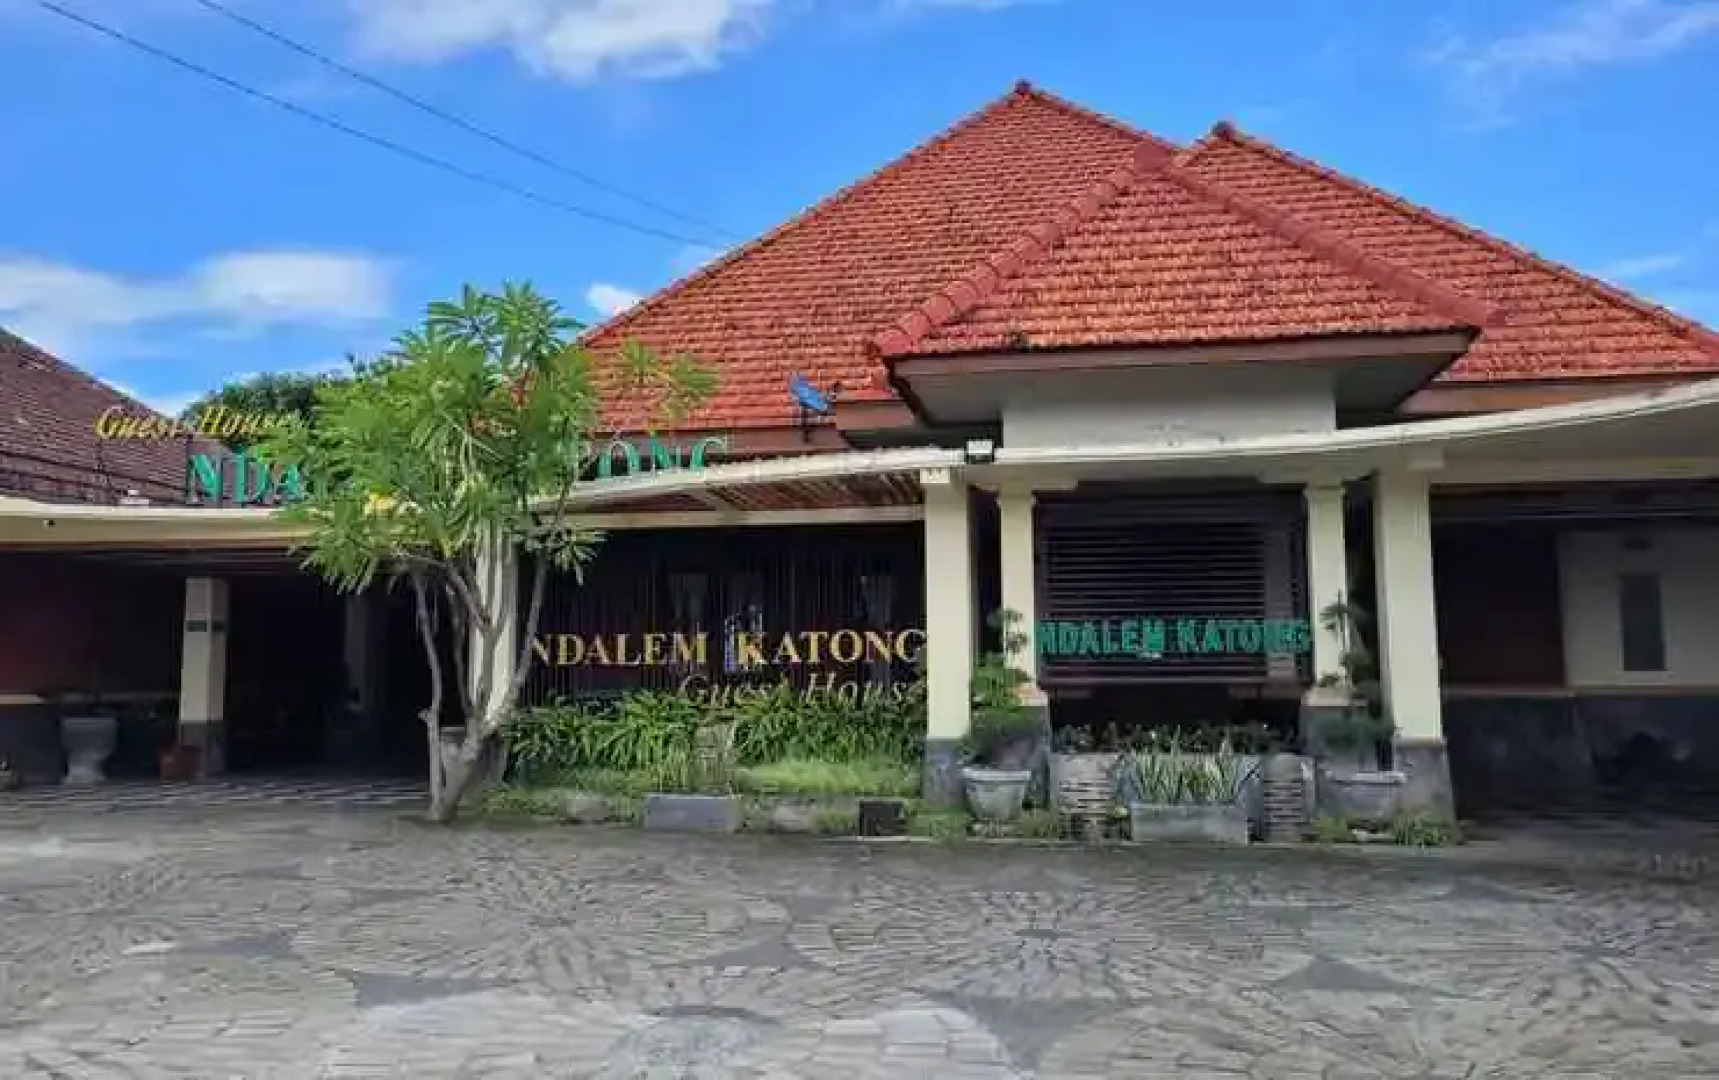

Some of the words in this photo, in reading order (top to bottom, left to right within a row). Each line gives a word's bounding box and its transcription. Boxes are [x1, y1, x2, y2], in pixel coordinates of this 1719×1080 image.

[188, 452, 300, 503] NDA
[531, 632, 709, 666] NDALEM
[737, 629, 926, 666] KATONG
[1037, 620, 1164, 654] NDALEM
